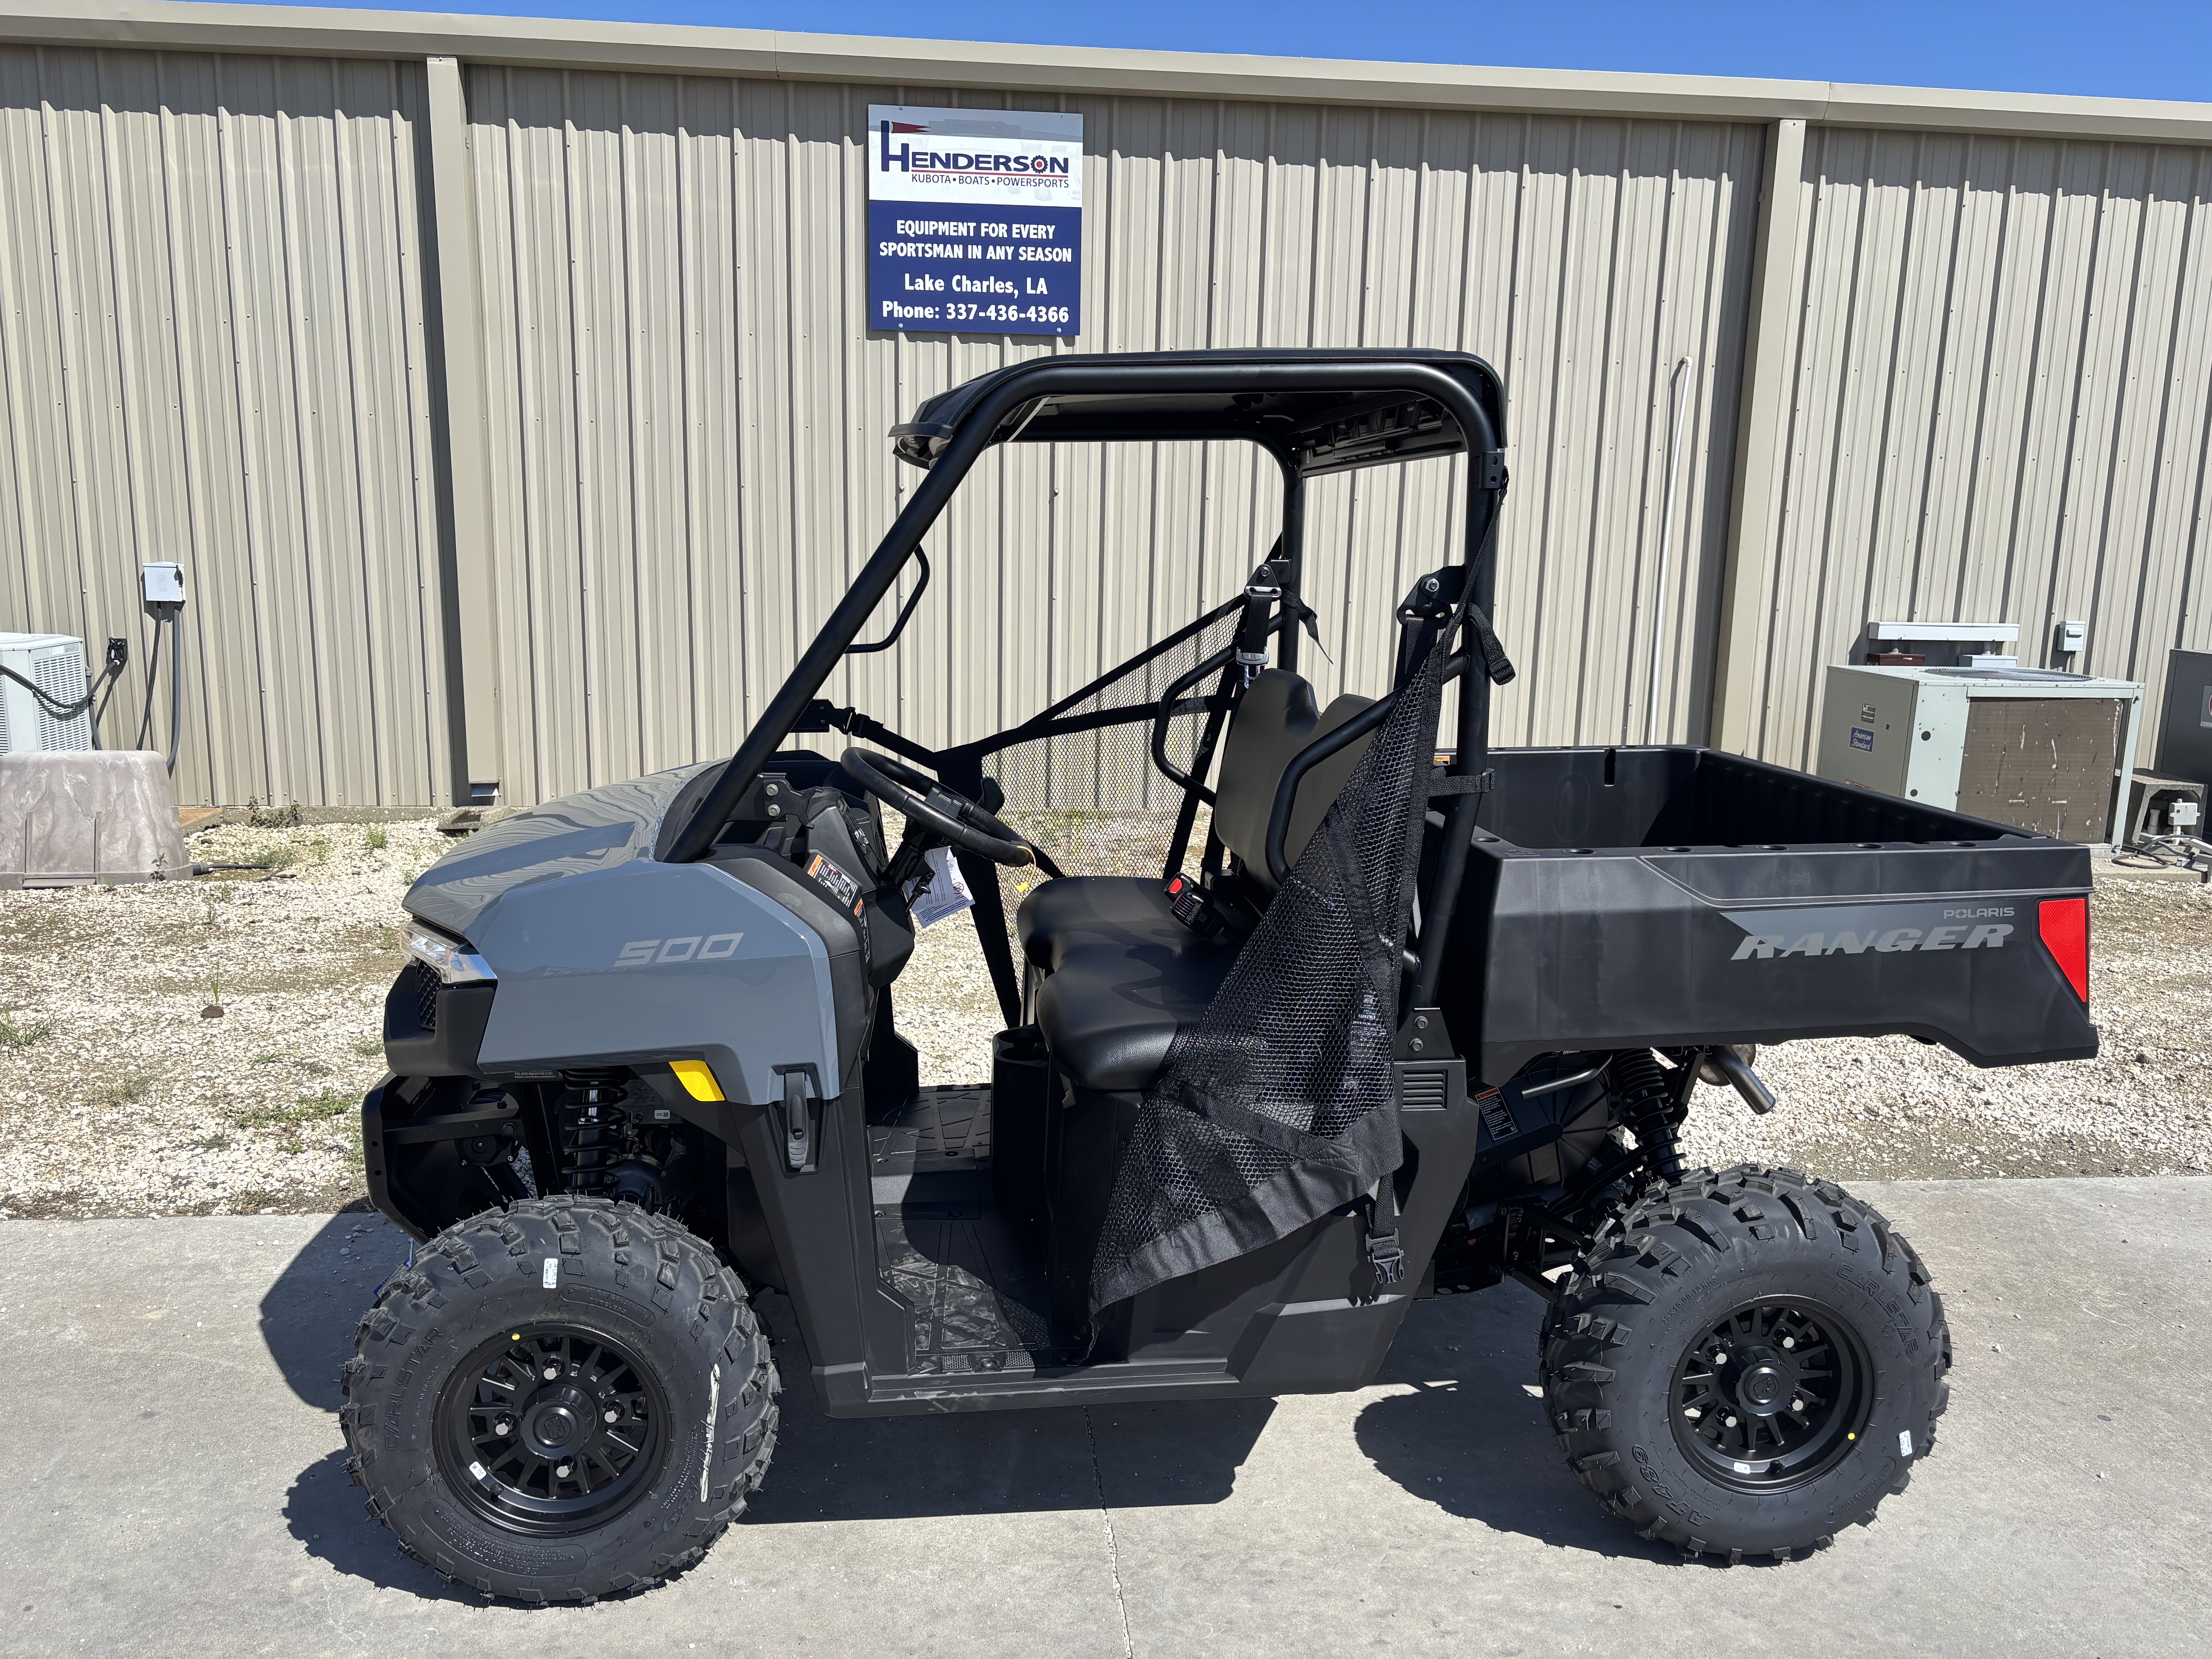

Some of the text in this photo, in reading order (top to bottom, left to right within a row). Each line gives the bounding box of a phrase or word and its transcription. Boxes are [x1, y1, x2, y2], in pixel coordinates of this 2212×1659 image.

[881, 120, 1069, 174] HENDERSON
[912, 174, 1069, 188] KUBOTA BOATS POWERSPORTS
[896, 220, 1056, 239] EQUIPMENT FOR EVERY
[879, 242, 1072, 262] SPORTSMAN IN ANY SEASON
[905, 273, 1048, 299] Lake Charles, LA
[883, 301, 1069, 323] Phone: 337-436-4366
[1851, 738, 1872, 750] Standard
[1853, 729, 1872, 741] American
[1943, 907, 2014, 919] POLARIS
[613, 932, 744, 967] 500
[1731, 924, 2014, 960] RANGER
[1837, 1263, 1918, 1356] CARLSTAR
[385, 1328, 444, 1450] CARLSTAR
[1631, 1445, 1714, 1527] AT489
